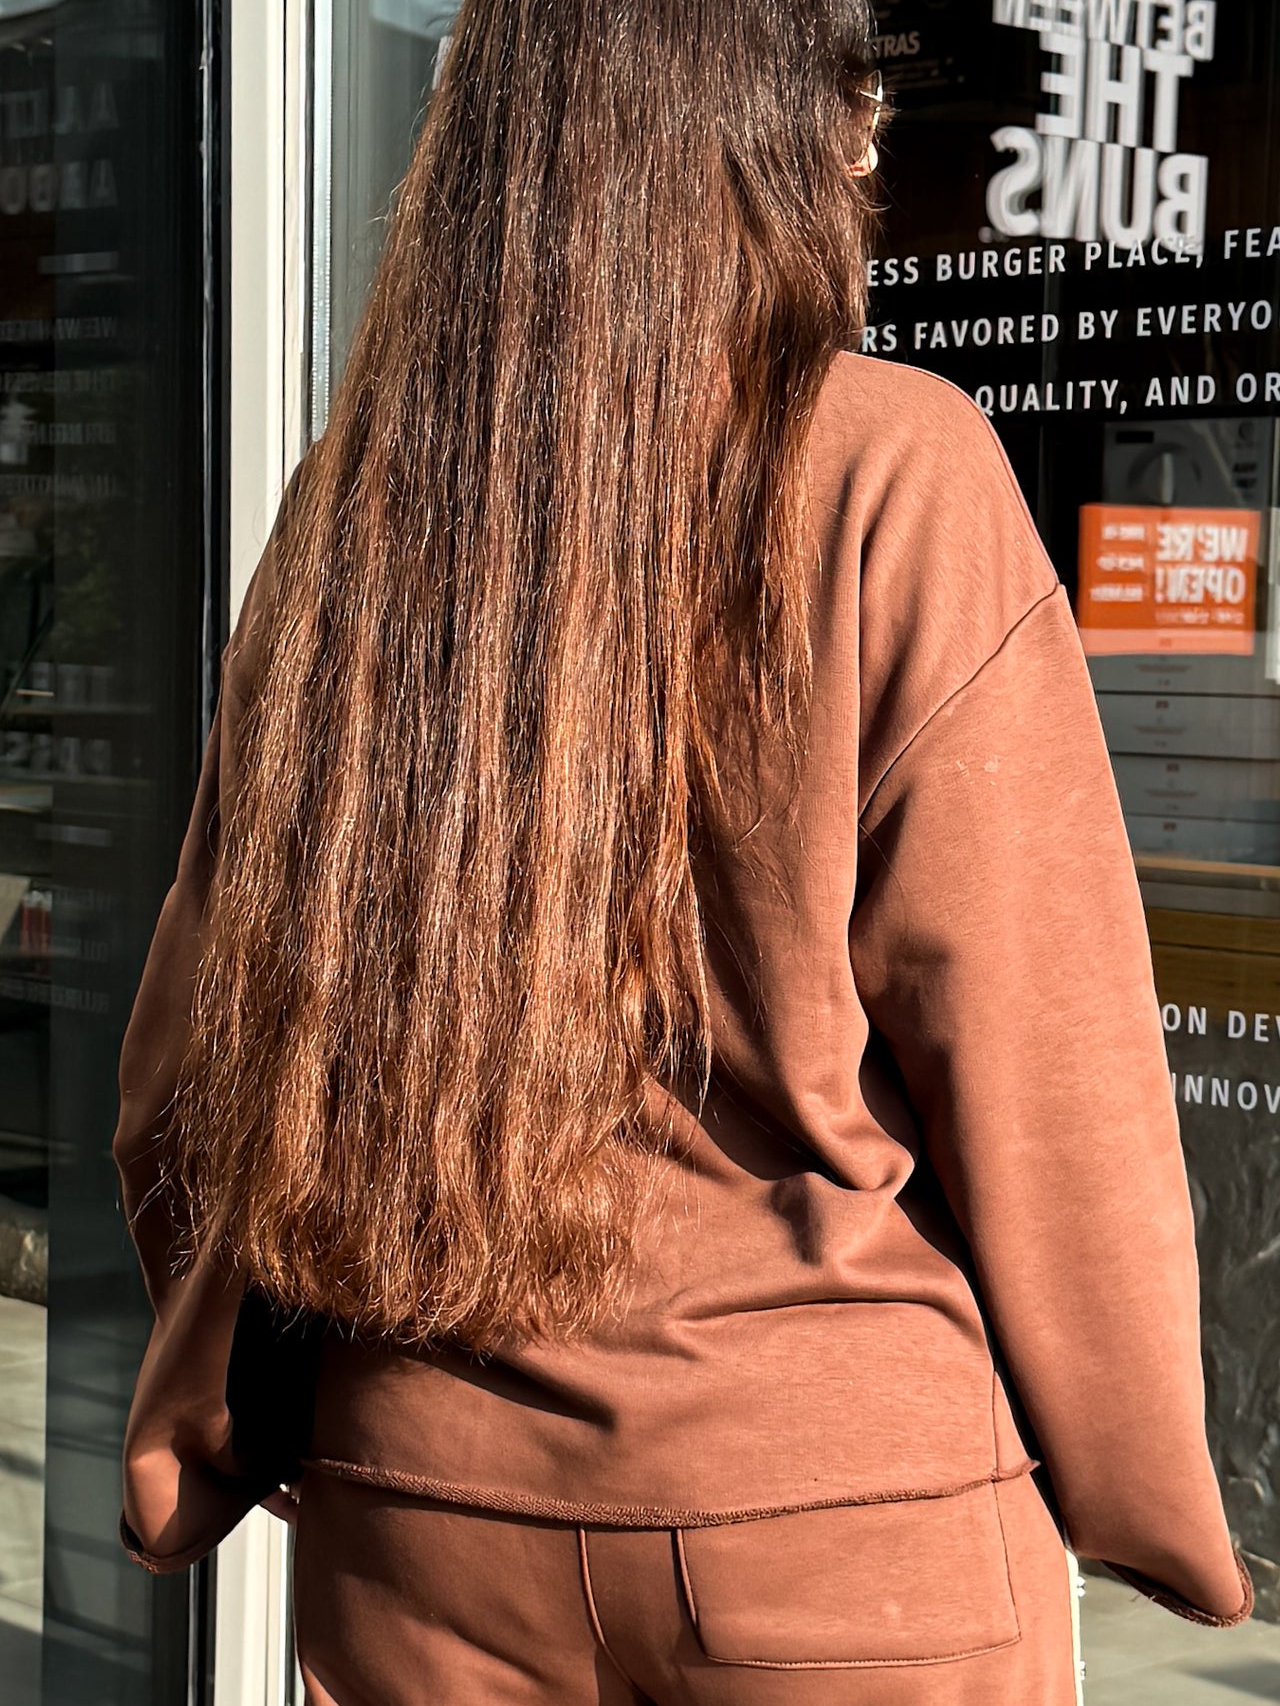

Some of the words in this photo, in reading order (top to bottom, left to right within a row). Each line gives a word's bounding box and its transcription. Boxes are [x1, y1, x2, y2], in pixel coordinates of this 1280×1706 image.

[936, 244, 1067, 282] BURGER
[914, 313, 1060, 350] FAVORED
[1078, 309, 1119, 340] BY
[975, 379, 1128, 417] QUALITY,
[1144, 374, 1216, 408] AND
[1161, 1003, 1208, 1036] ON
